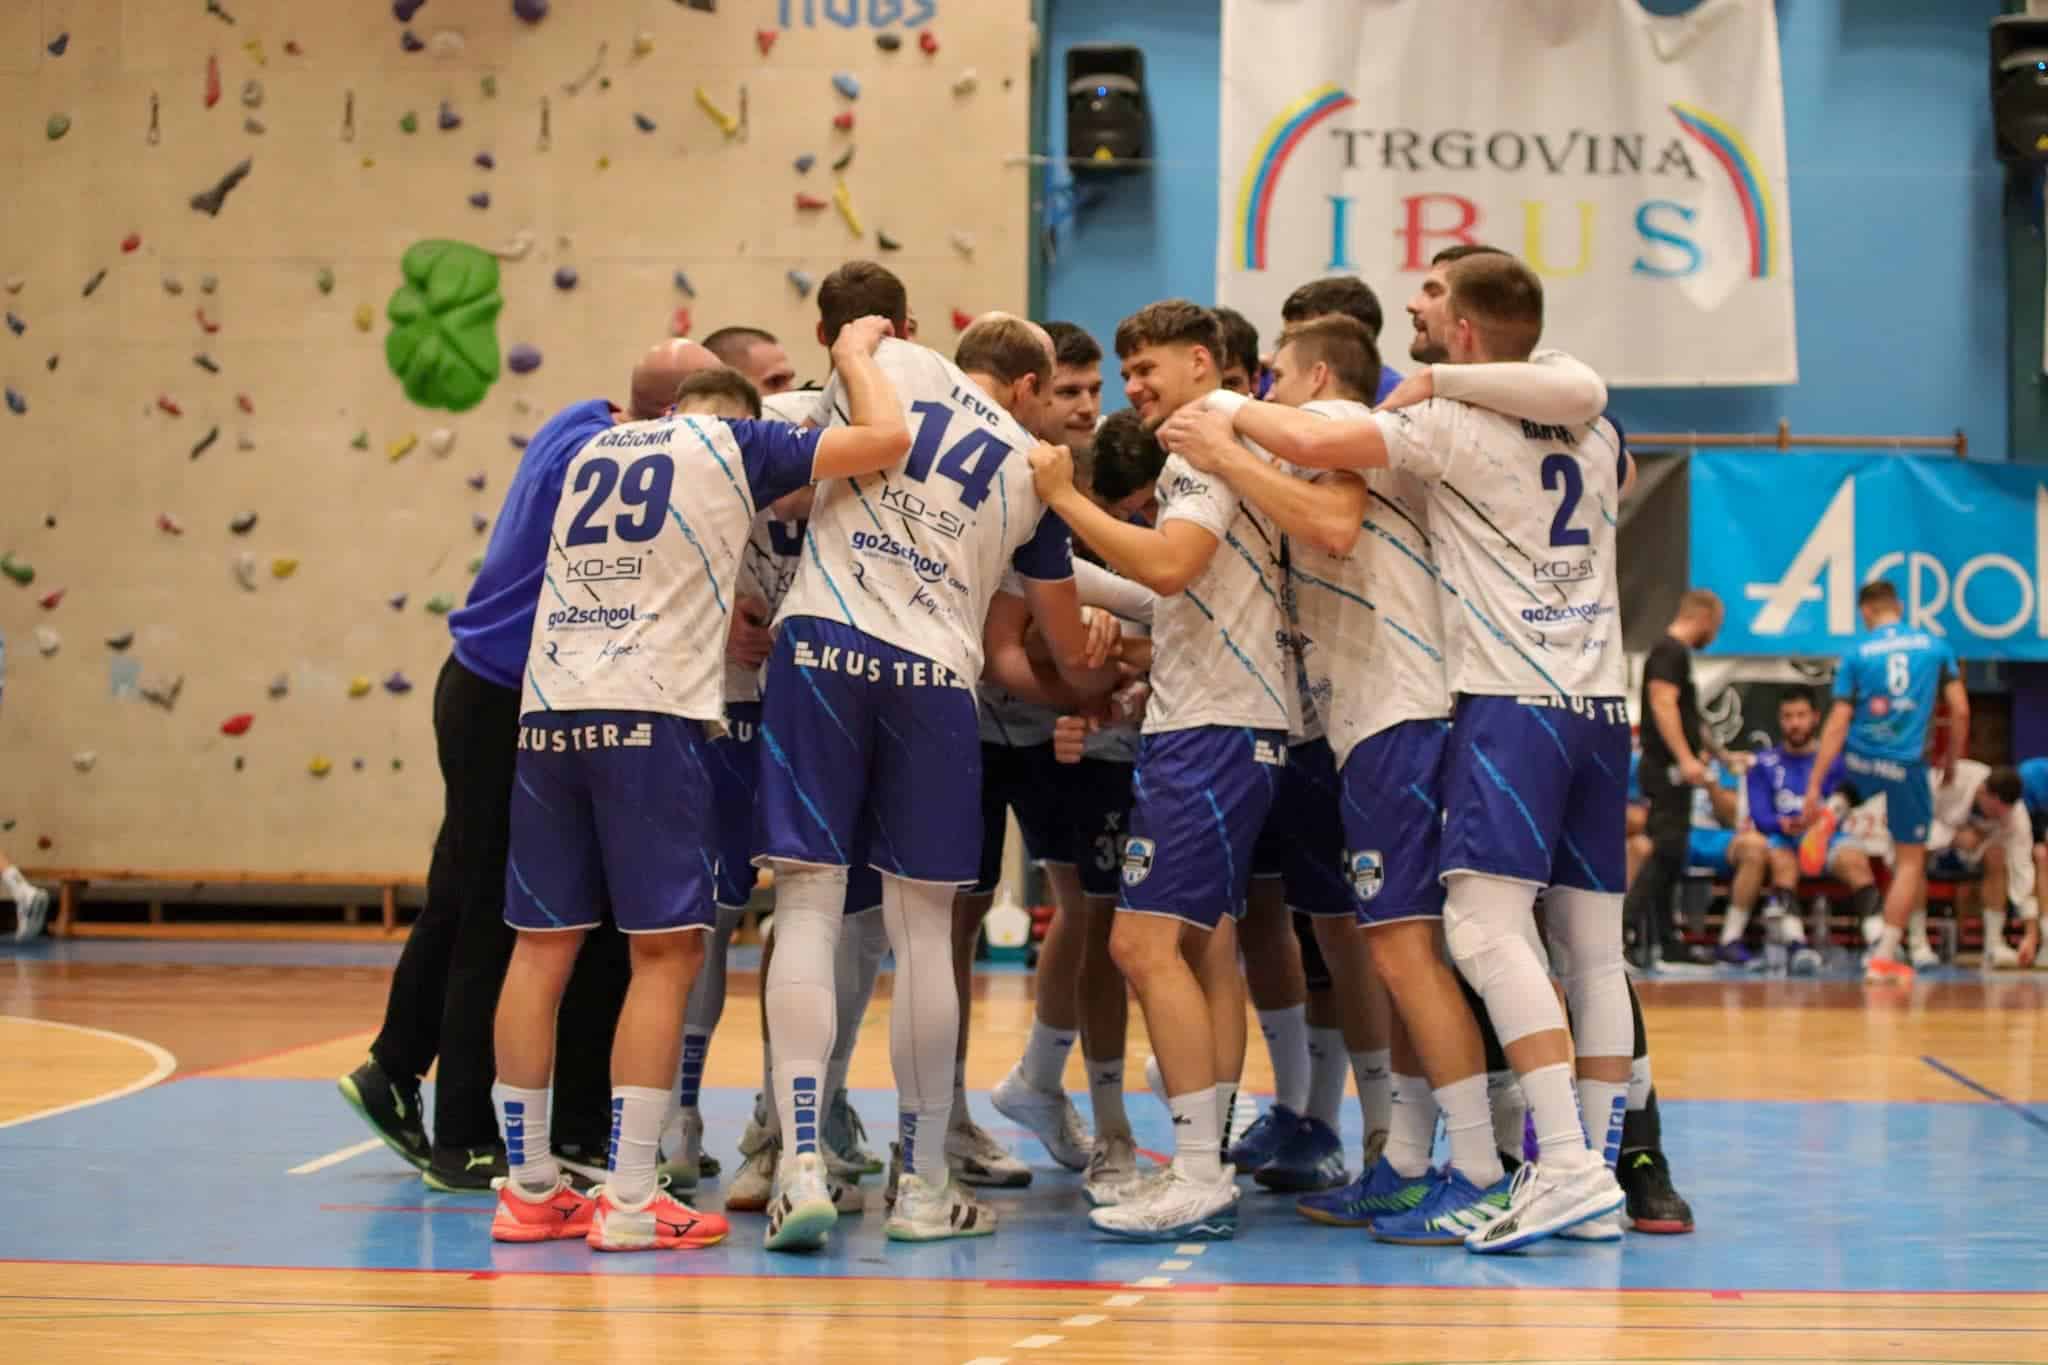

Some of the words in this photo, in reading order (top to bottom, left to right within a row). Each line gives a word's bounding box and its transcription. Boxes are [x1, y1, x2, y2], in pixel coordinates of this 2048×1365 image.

[1331, 128, 1702, 179] TRGOVINA
[1325, 193, 1703, 279] IBUS
[951, 385, 1001, 427] LEVC
[904, 400, 1016, 512] 14
[565, 454, 675, 548] 29
[880, 484, 966, 539] KO-SI
[1540, 453, 1591, 547] 2
[566, 556, 642, 578] KO-SI
[822, 646, 952, 688] KUSTER
[517, 723, 620, 752] KUSTER
